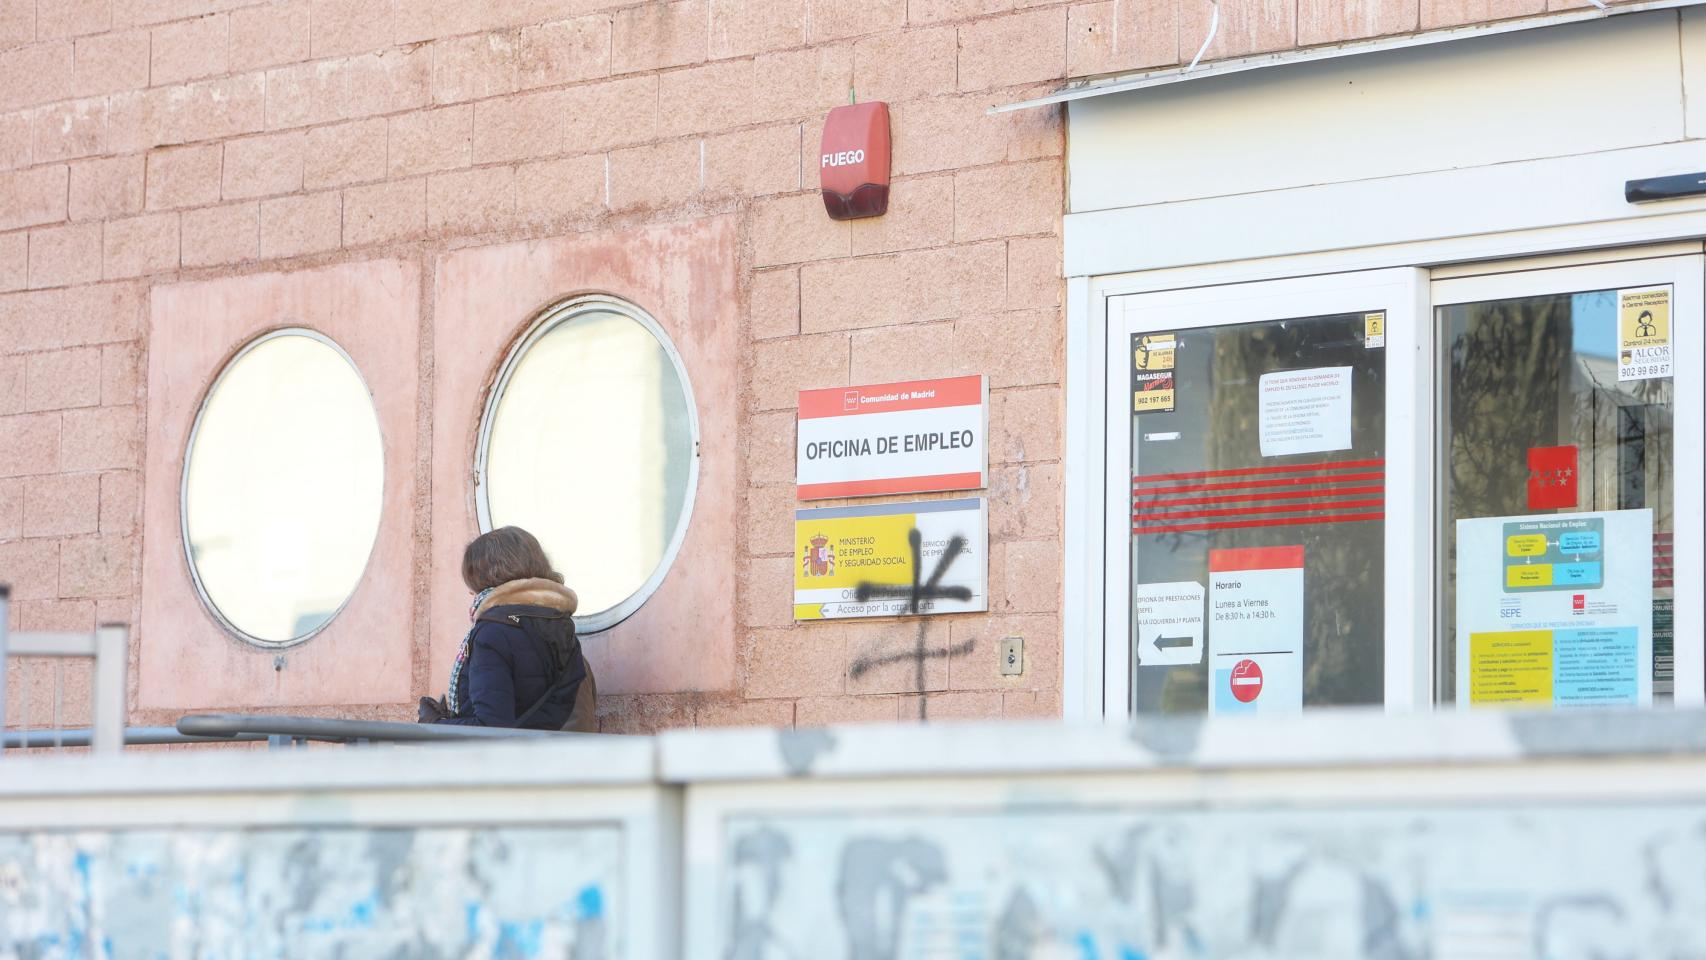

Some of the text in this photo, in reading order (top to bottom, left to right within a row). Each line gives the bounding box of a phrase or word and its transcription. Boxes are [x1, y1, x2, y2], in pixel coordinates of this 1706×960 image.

[822, 149, 865, 168] FUEGO
[1636, 346, 1669, 358] ALCOR
[1635, 356, 1669, 364] SEGURIDAD
[1622, 364, 1670, 377] 902 99 69 67
[860, 393, 899, 404] Comunidad
[911, 389, 935, 400] Madrid
[806, 429, 974, 460] OFICINA DE EMPLEO
[839, 536, 875, 545] MINISTERIO
[922, 540, 945, 548] SERVICIO
[839, 547, 874, 557] DE EMPLEO
[839, 556, 906, 568] Y SEGURIDAD SOCIAL
[1215, 581, 1242, 590] Horario
[1165, 594, 1200, 602] PRESTACIONES
[1215, 600, 1236, 608] Lunes
[1243, 598, 1269, 608] Viernes
[837, 604, 865, 614] Acceso
[866, 604, 881, 615] por
[882, 601, 889, 612] la
[1500, 608, 1521, 618] SEPE
[1215, 612, 1224, 621] De
[1225, 612, 1238, 620] 8:30
[1239, 612, 1246, 620] h.
[1252, 611, 1268, 619] 14:30
[1269, 610, 1275, 618] h.
